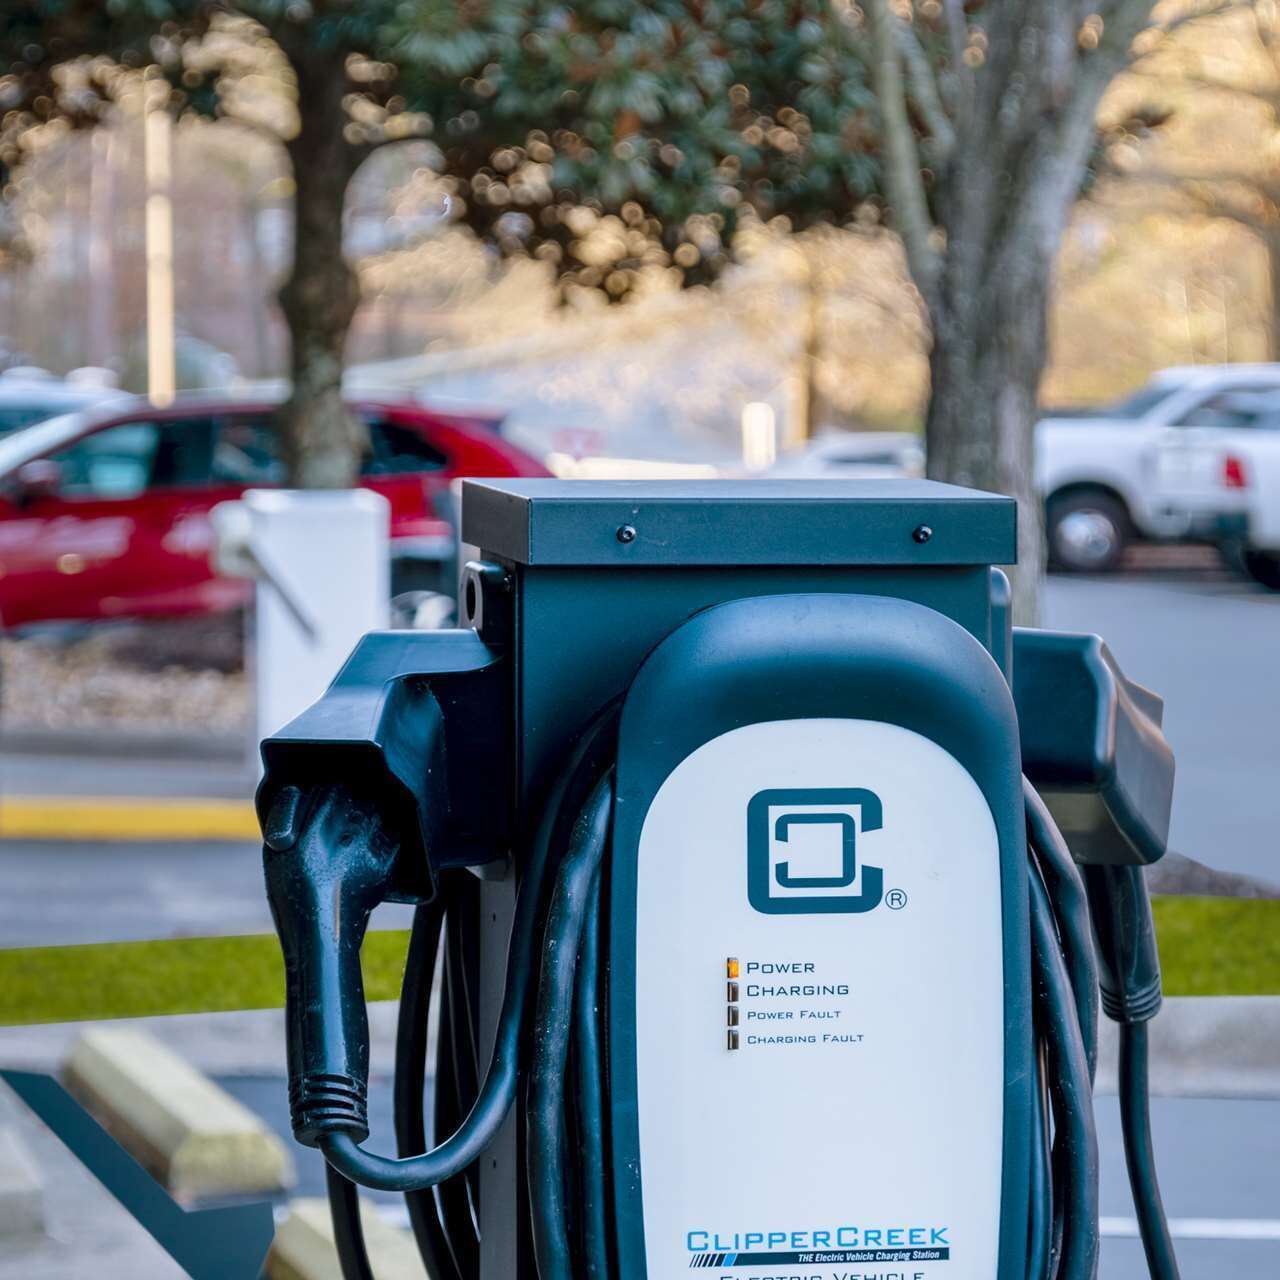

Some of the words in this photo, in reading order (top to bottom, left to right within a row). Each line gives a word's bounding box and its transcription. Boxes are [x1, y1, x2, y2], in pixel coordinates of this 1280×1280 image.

[746, 961, 815, 975] POWER
[746, 984, 849, 997] CHARGING
[747, 1011, 794, 1021] POWER
[799, 1010, 841, 1020] FAULT
[747, 1035, 817, 1045] CHARGING
[822, 1033, 864, 1043] FAULT
[798, 1253, 814, 1263] THE
[815, 1252, 845, 1262] Electric
[846, 1251, 874, 1261] Vehicle
[876, 1250, 911, 1261] Charging
[912, 1249, 940, 1260] Station
